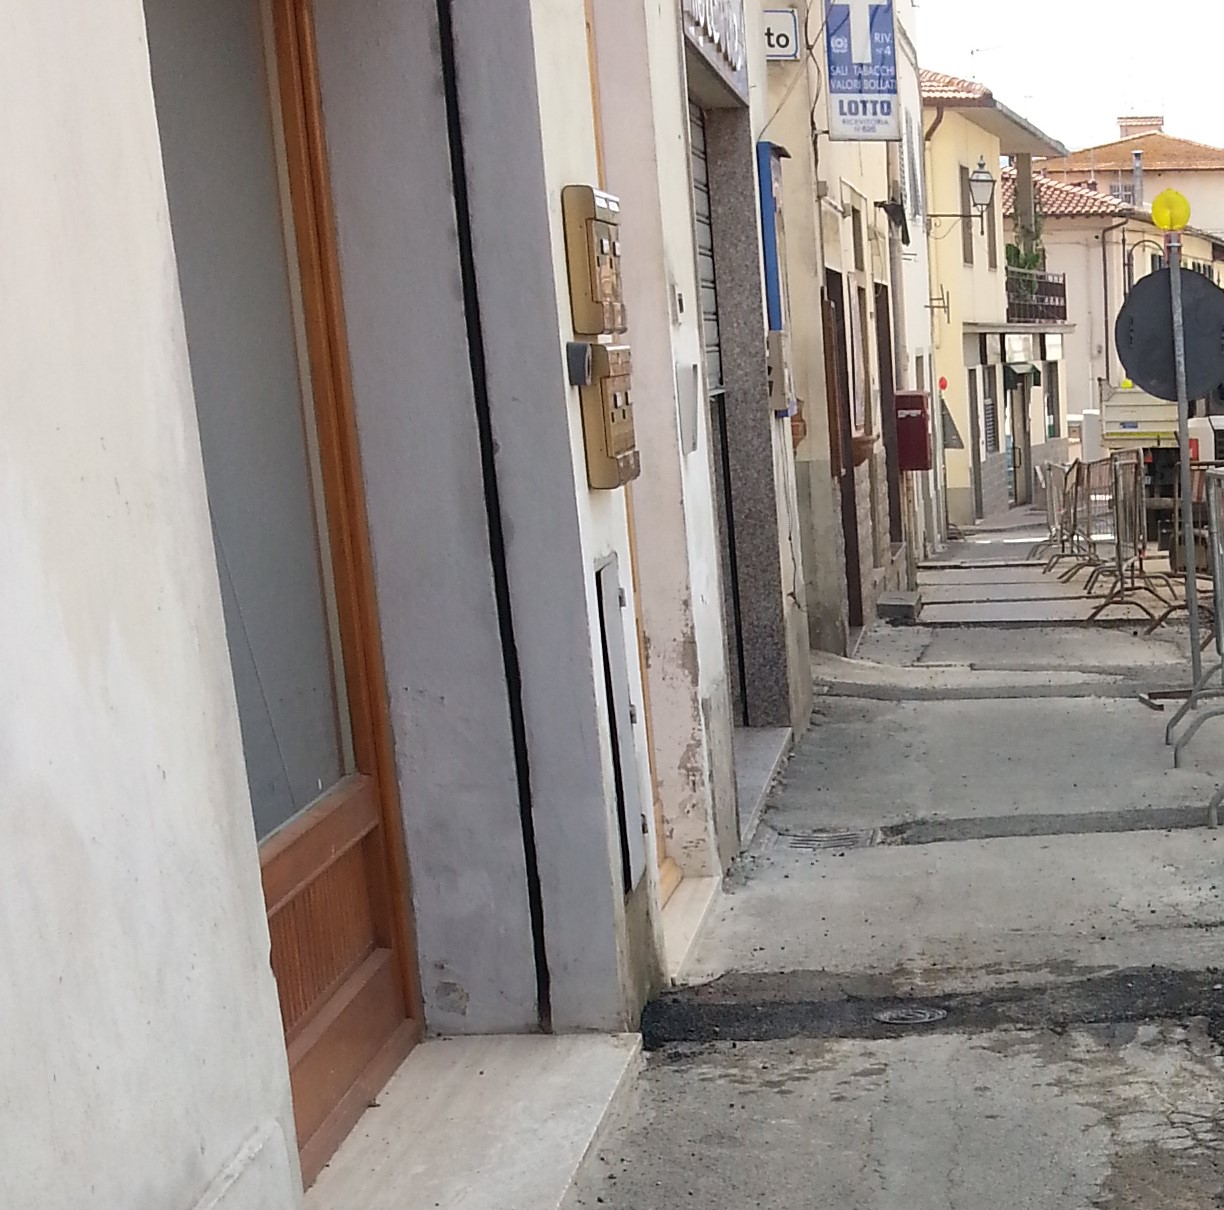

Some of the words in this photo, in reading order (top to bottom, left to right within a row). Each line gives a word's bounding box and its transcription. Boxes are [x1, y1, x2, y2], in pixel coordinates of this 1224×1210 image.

[874, 32, 893, 43] RIV.
[884, 45, 892, 56] 4
[830, 65, 848, 76] SALI
[853, 65, 895, 76] TABACCHI
[830, 79, 861, 90] VALORI
[838, 99, 892, 116] LOTTO
